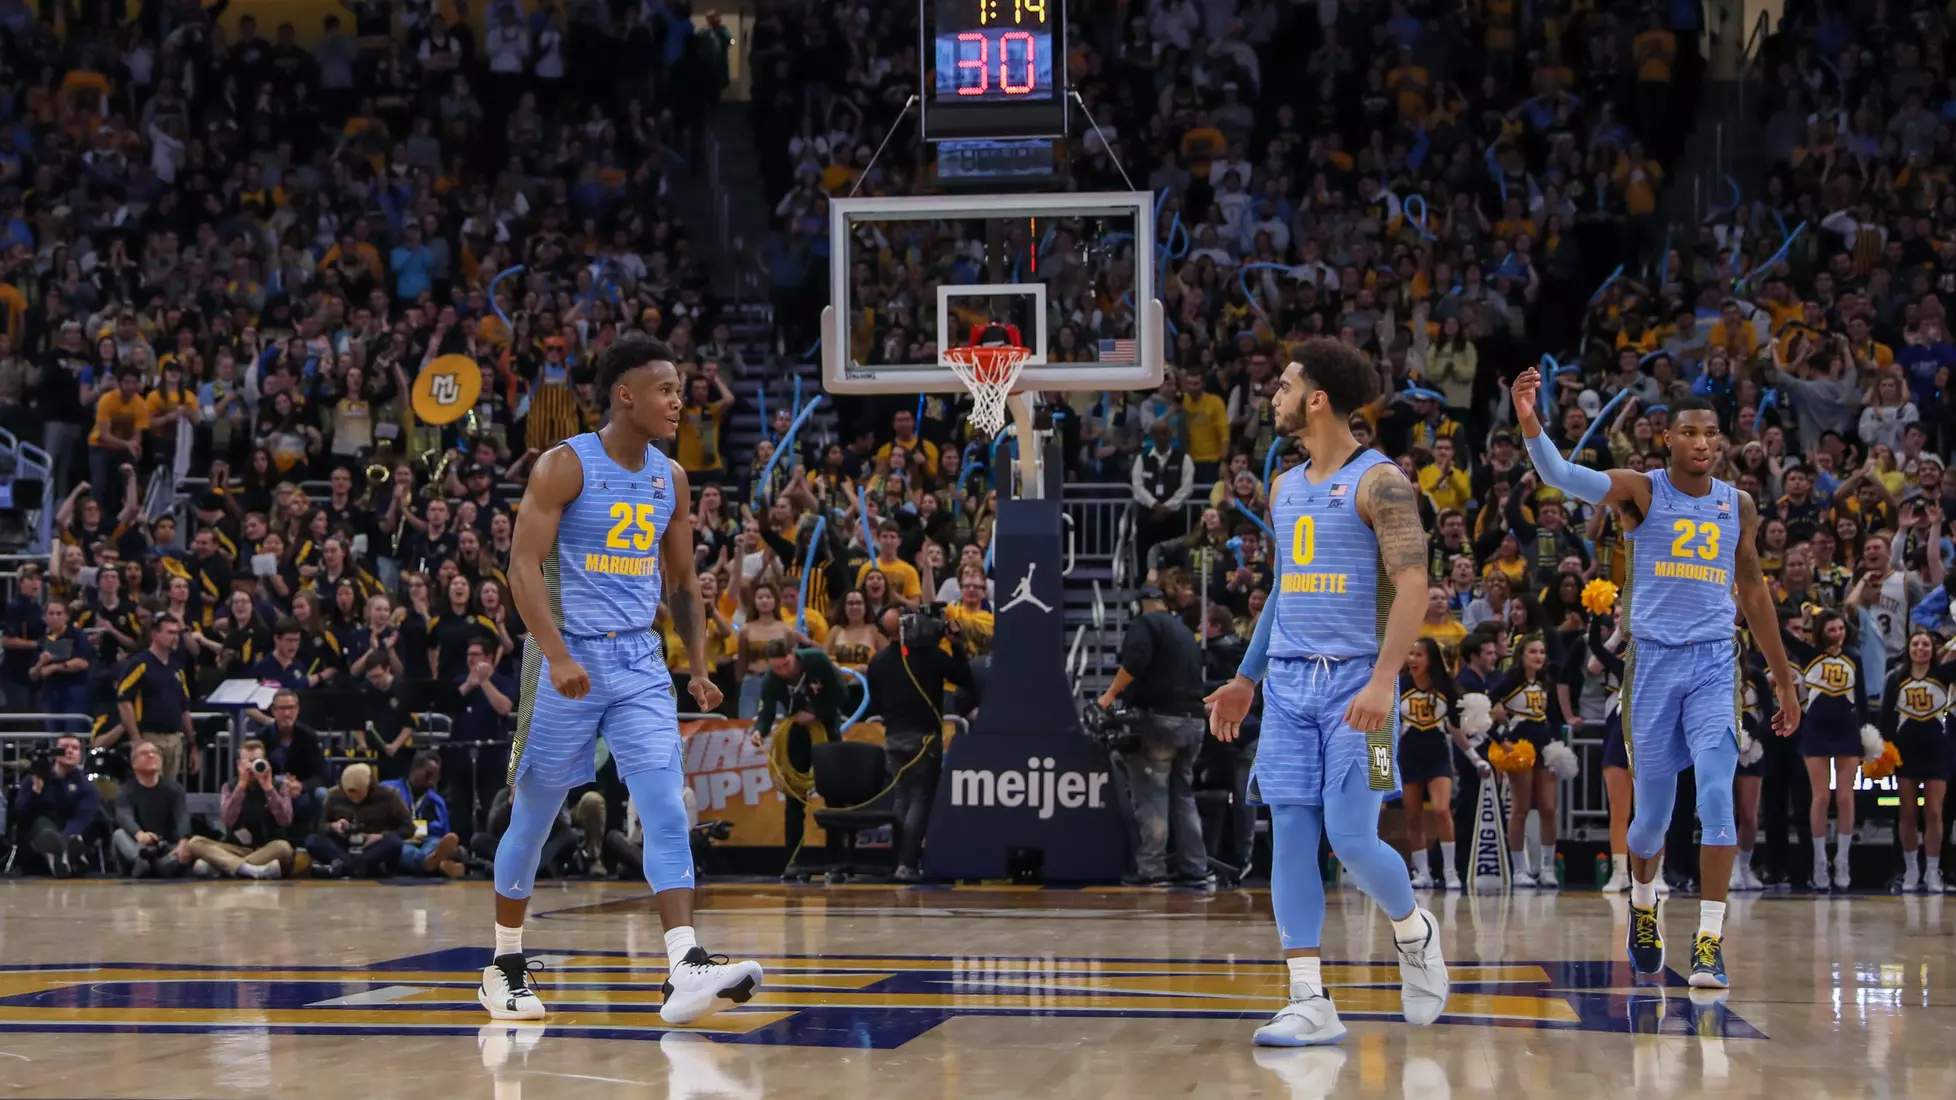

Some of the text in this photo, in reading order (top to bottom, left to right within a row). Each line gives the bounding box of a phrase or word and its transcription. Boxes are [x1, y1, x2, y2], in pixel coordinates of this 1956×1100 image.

[957, 31, 1035, 96] 30
[431, 374, 460, 404] MU
[606, 502, 655, 550] 25
[1292, 515, 1315, 566] 0
[1671, 518, 1721, 560] 23
[1654, 561, 1728, 585] MARQUETTE
[1822, 662, 1848, 689] MU
[1906, 686, 1933, 713] MU
[1373, 745, 1390, 777] MU
[951, 756, 1109, 819] meijer
[1476, 828, 1500, 877] RING
